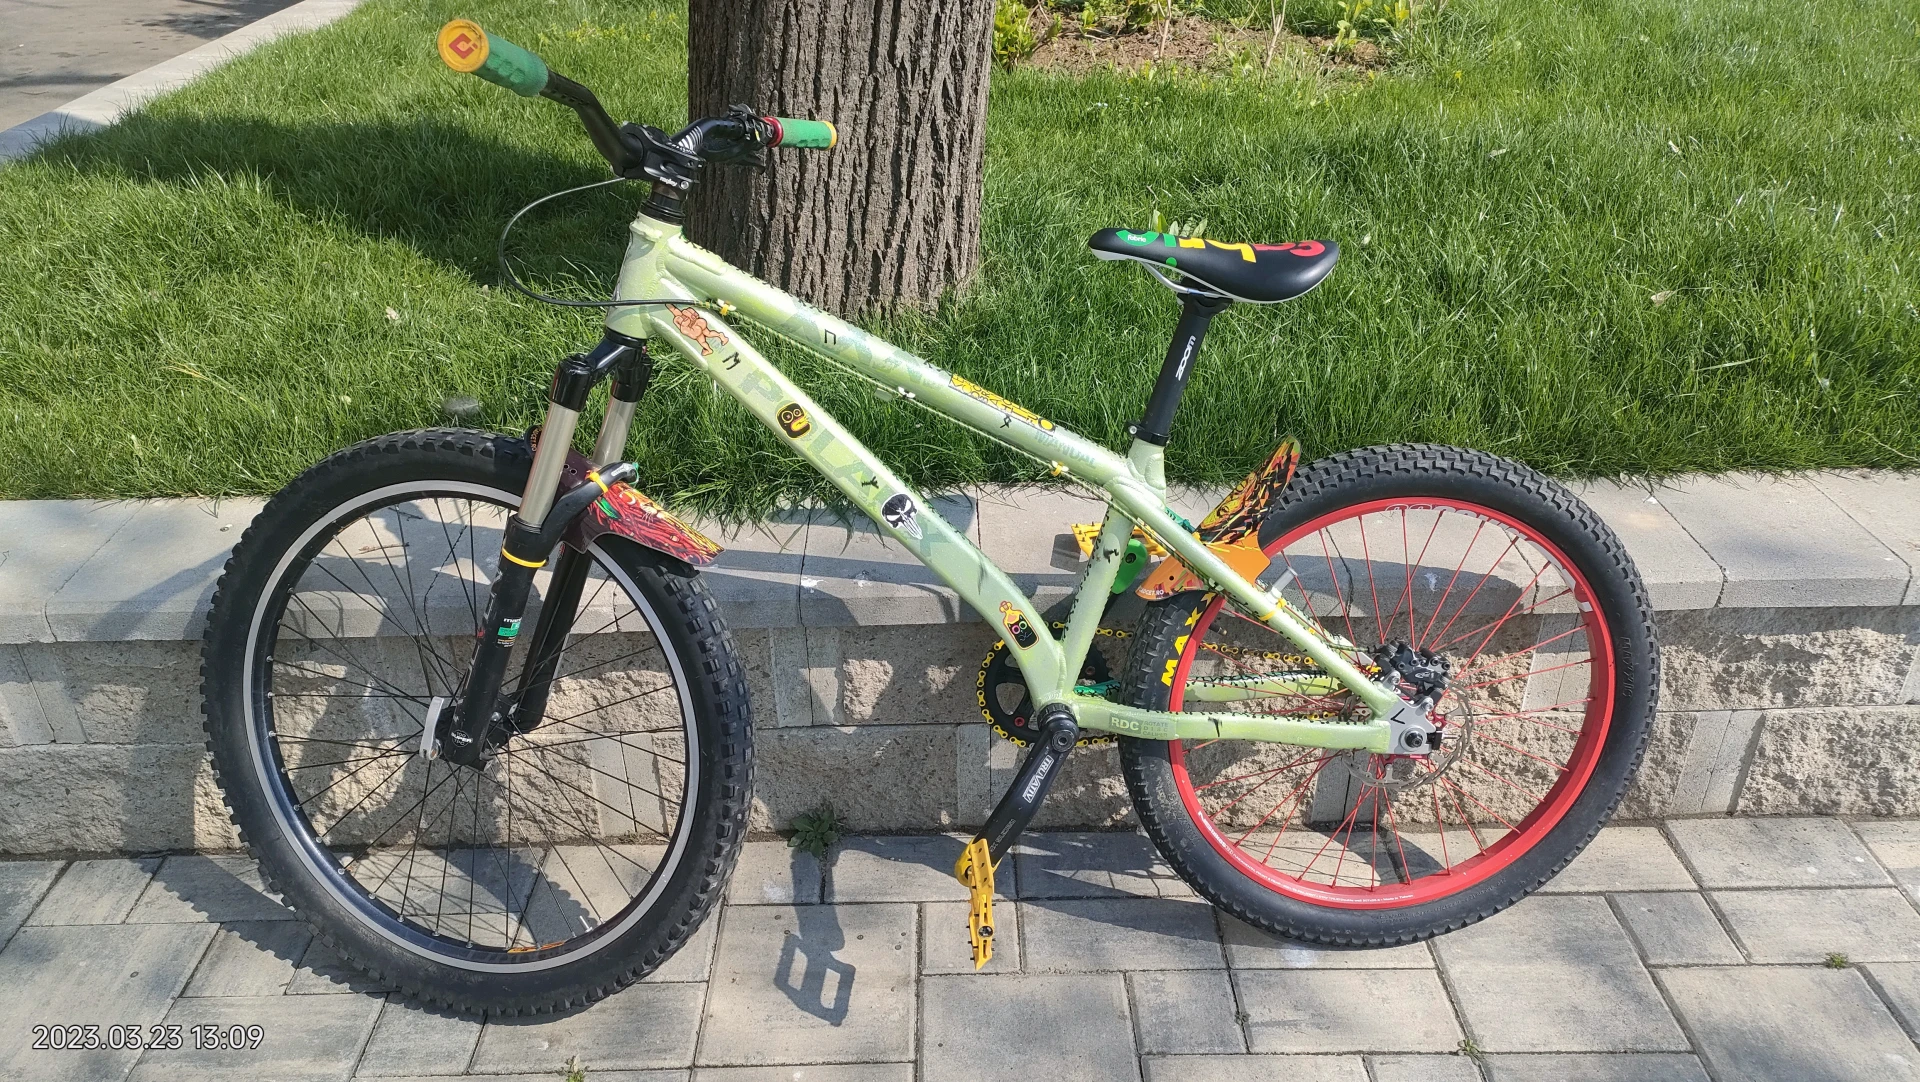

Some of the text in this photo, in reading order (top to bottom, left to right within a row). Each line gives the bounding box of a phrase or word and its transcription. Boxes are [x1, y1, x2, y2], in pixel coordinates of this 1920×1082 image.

[1127, 234, 1147, 243] fabric
[1111, 716, 1140, 731] RDC
[1023, 755, 1055, 803] TRUVATIV
